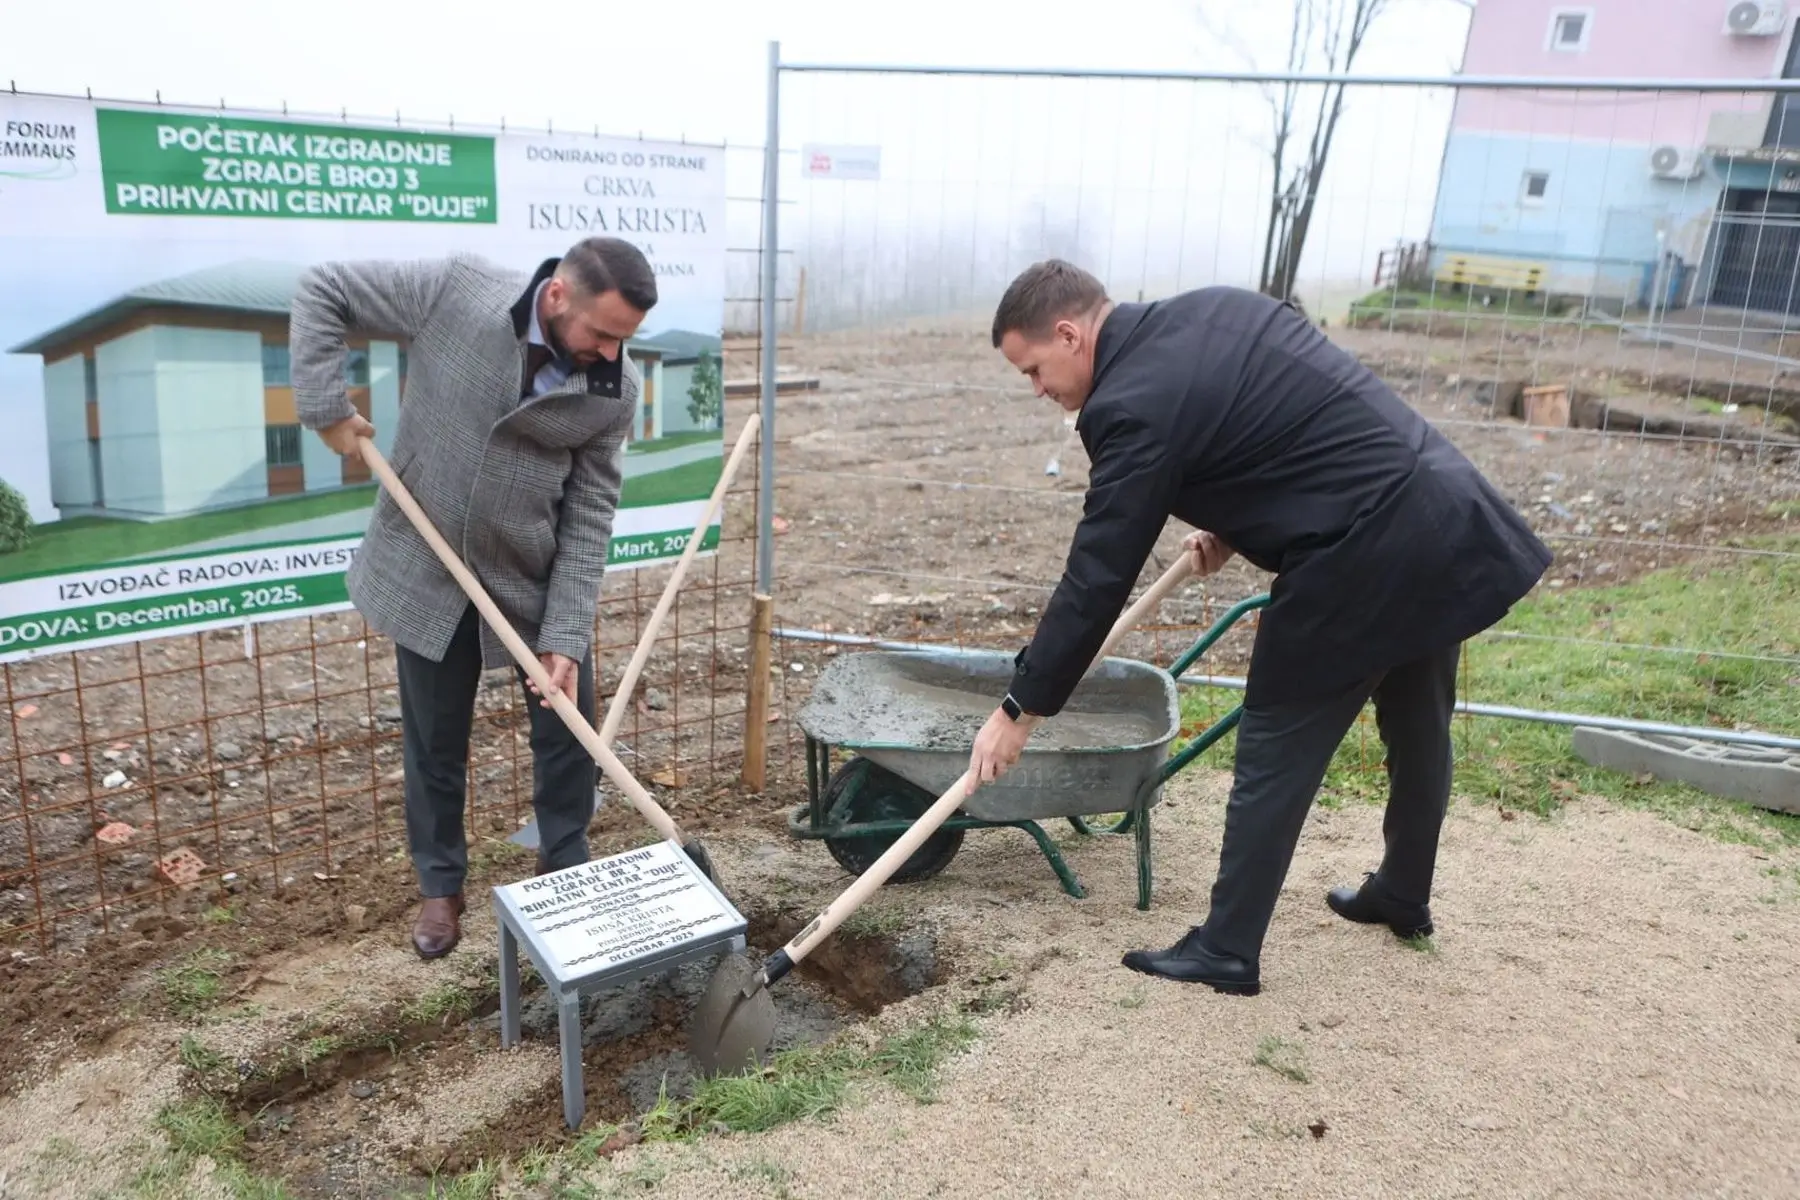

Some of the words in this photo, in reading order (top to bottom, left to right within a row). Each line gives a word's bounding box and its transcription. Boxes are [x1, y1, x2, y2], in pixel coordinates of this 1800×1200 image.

[6, 120, 76, 140] FORUM
[157, 122, 298, 157] POČETAK
[304, 134, 452, 166] IZGRADNJE
[526, 145, 618, 166] DONIRANO
[621, 153, 646, 168] OD
[649, 154, 707, 171] STRANE
[201, 156, 322, 186] ZGRADE
[328, 163, 398, 189] BROJ
[403, 167, 420, 190] 3
[116, 182, 279, 213] PRIHVATNI
[285, 189, 394, 216] CENTAR
[584, 174, 656, 199] CRKVA
[528, 203, 609, 232] ISUSA
[617, 206, 707, 235] KRISTA
[653, 262, 696, 278] DANA
[613, 540, 659, 559] Mart,
[663, 534, 707, 552] 20.
[58, 568, 171, 601] IZVOĐAČ
[178, 558, 279, 585] RADOVA:
[95, 594, 236, 631] Decembar,
[240, 584, 304, 610] 2025.
[588, 850, 655, 874] IZGRADNJE
[552, 874, 604, 895] ZGRADE
[608, 868, 631, 879] BR.
[632, 863, 641, 872] 3
[592, 873, 643, 893] CENTAR
[590, 893, 640, 912] DONATOR
[609, 907, 641, 921] CRKVA
[585, 920, 625, 937] ISUSA
[628, 904, 675, 924] KRISTA
